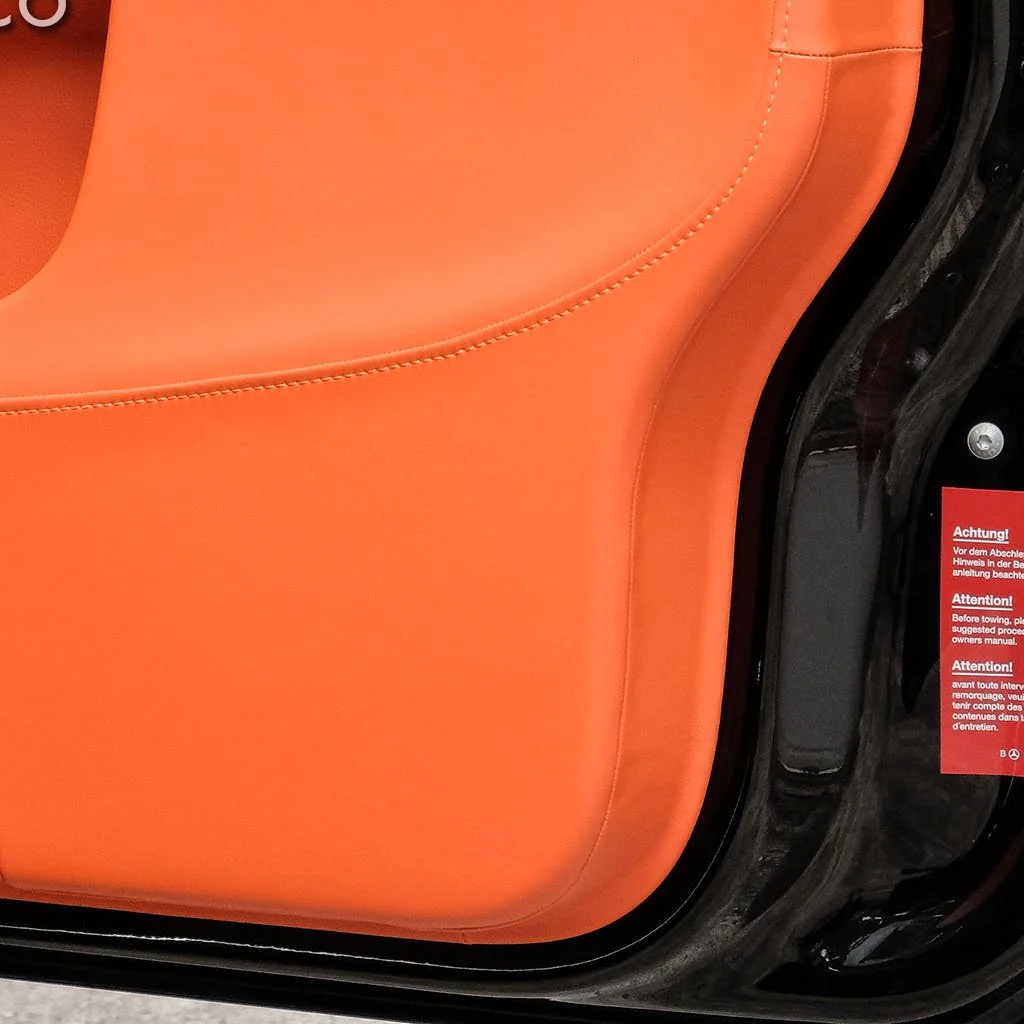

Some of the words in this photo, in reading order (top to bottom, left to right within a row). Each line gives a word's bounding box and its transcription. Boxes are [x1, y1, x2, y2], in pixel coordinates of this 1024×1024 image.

[953, 526, 1009, 541] Achtung!
[953, 546, 968, 555] Vor
[969, 547, 988, 556] dem
[953, 557, 985, 567] Hinweis
[987, 559, 995, 567] in
[996, 560, 1012, 568] der
[952, 568, 991, 579] anleitung
[952, 593, 1013, 606] Attention!
[952, 613, 980, 623] Before
[981, 615, 1012, 626] towing,
[952, 626, 996, 635] suggested
[952, 636, 983, 645] owners
[984, 637, 1017, 646] manual.
[952, 660, 1013, 673] Attention!
[952, 681, 975, 689] avant
[977, 681, 999, 690] toute
[952, 692, 1005, 701] remorquage,
[952, 701, 971, 710] tenir
[973, 702, 1005, 712] compte
[1006, 703, 1023, 712] des
[952, 712, 996, 721] contenues
[998, 713, 1019, 722] dans
[999, 749, 1007, 758] B
